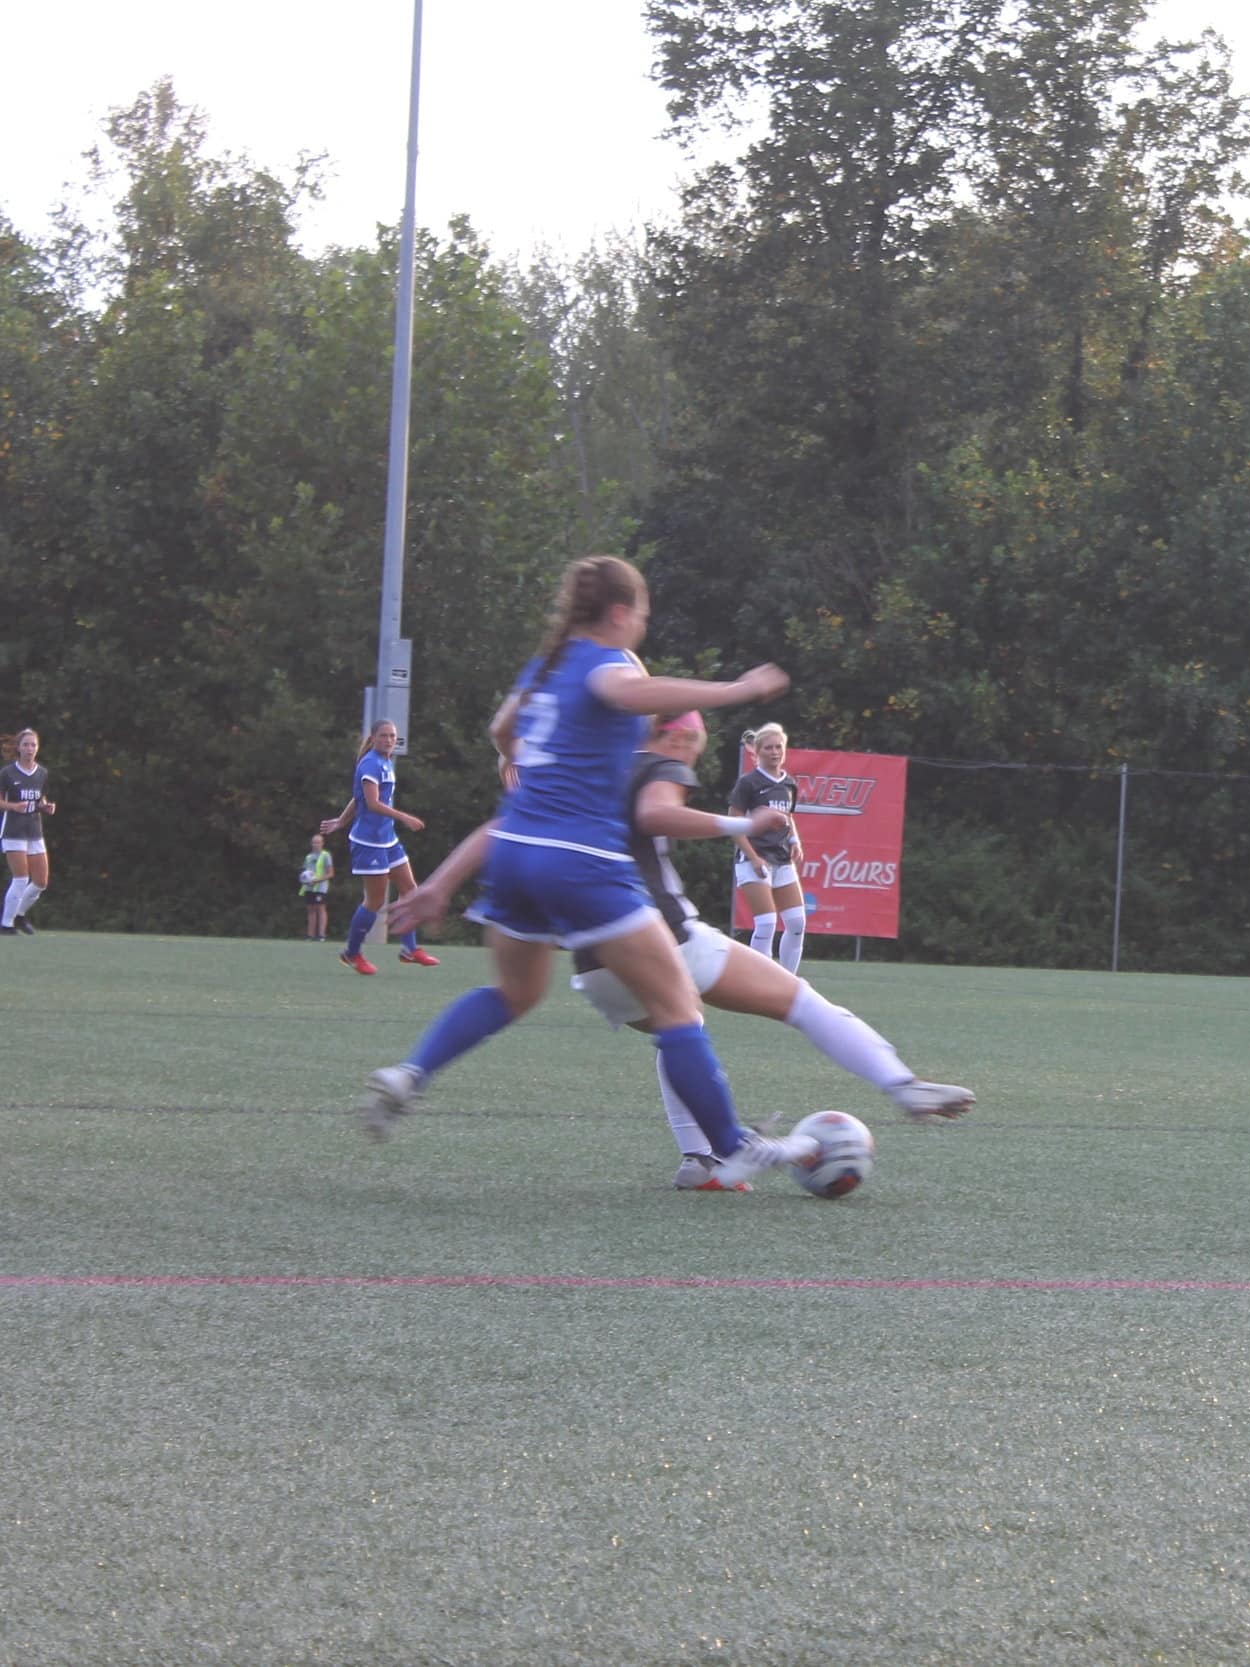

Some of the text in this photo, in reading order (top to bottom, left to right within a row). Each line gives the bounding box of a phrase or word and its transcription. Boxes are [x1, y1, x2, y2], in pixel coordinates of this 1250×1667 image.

[20, 789, 41, 801] NGU
[795, 774, 877, 809] NGU
[802, 849, 897, 889] IT YOURS
